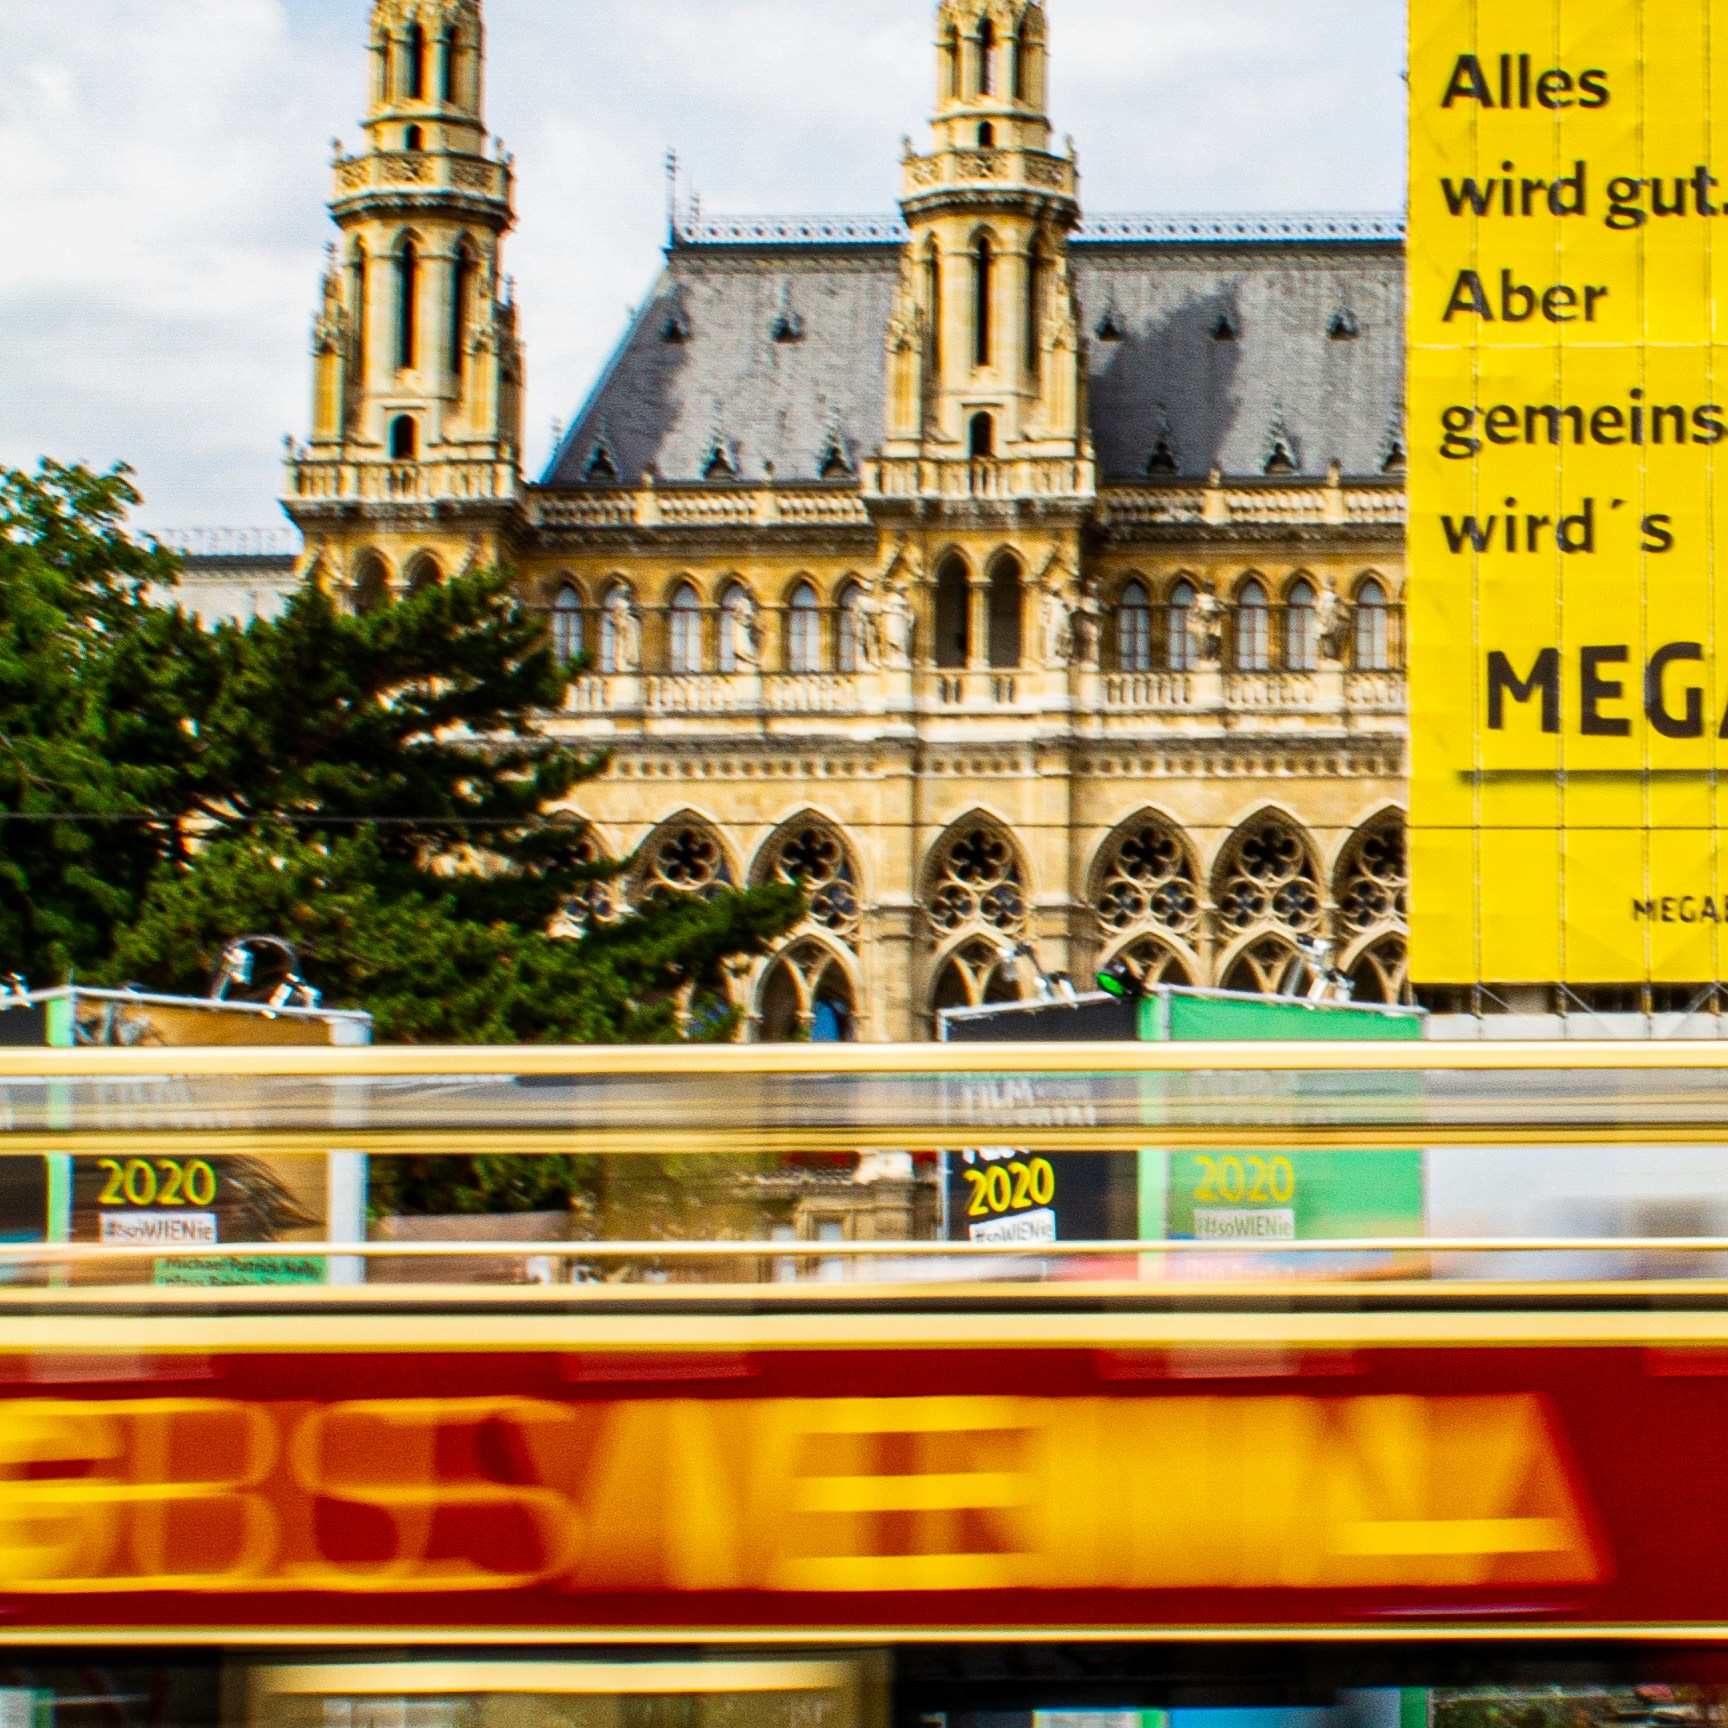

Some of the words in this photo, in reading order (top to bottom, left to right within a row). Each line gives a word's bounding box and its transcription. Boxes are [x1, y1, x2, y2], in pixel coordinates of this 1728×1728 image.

[1440, 53, 1610, 110] Alles
[1440, 160, 1587, 217] wird
[1441, 268, 1609, 323] Aber
[97, 1157, 217, 1206] 2020
[963, 1157, 1055, 1216] 2020
[1193, 1155, 1295, 1202] 2020
